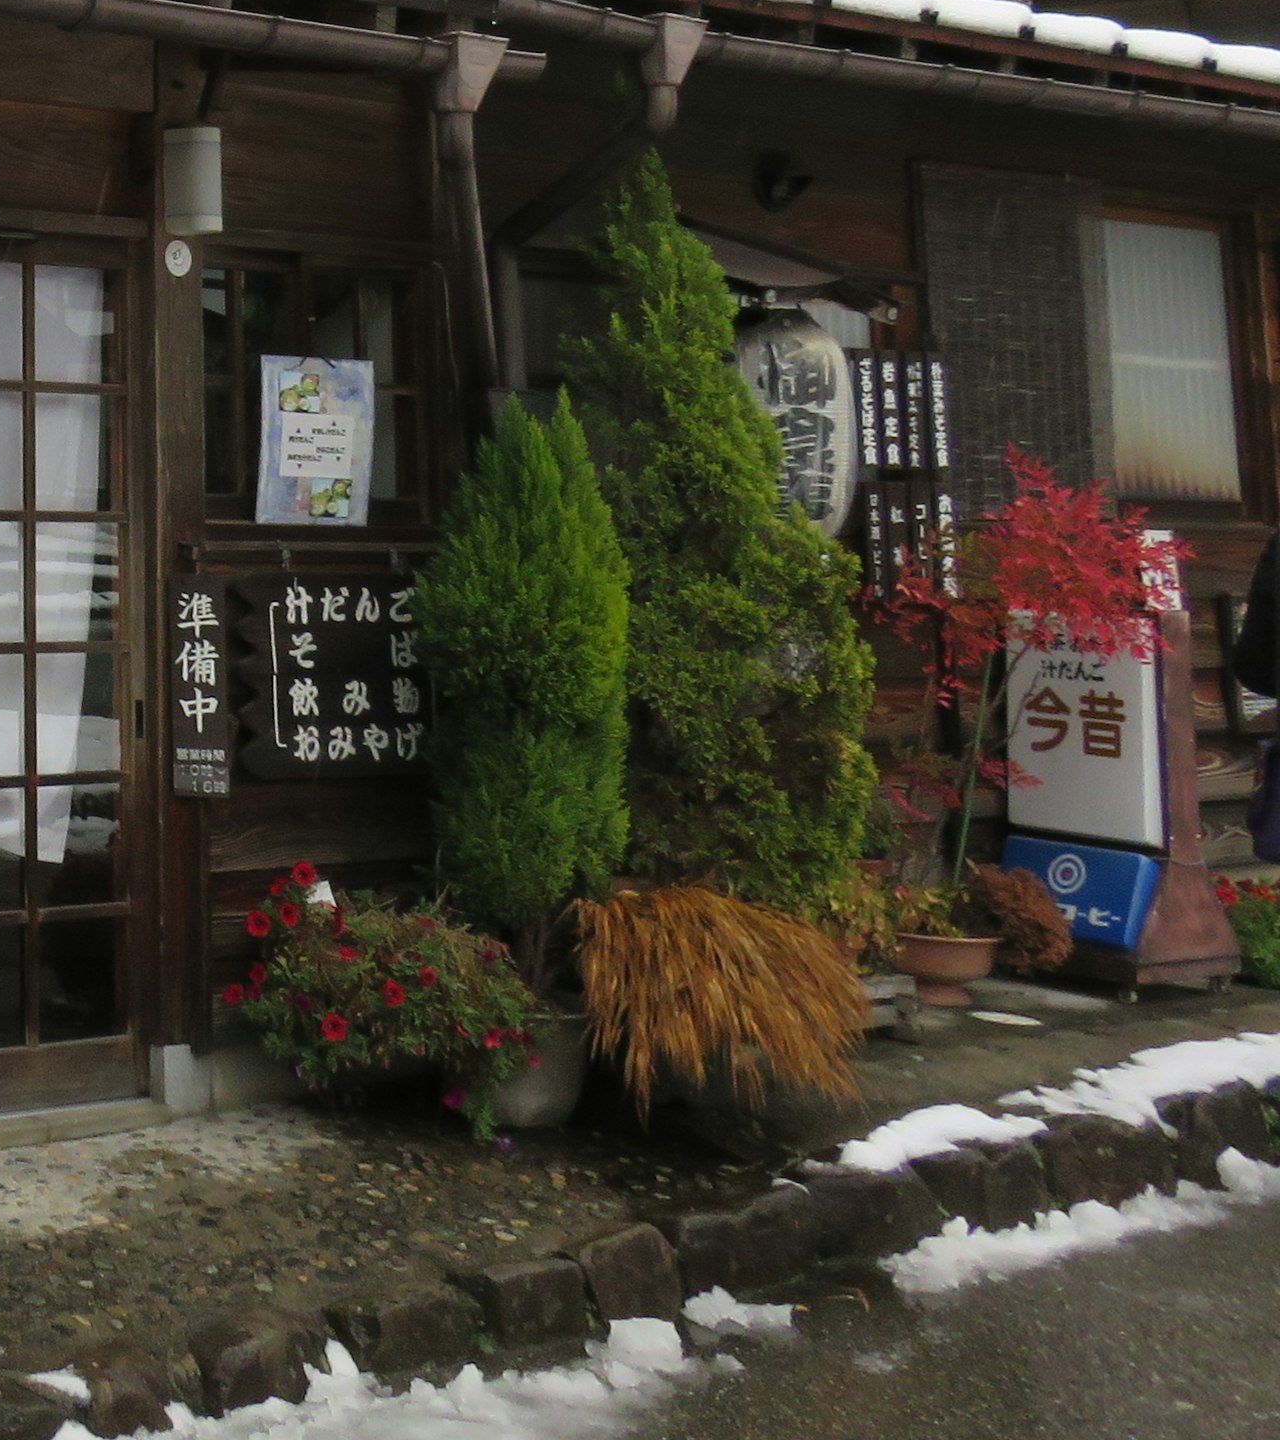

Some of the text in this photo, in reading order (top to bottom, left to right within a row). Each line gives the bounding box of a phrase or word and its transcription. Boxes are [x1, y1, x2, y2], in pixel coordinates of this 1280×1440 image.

[881, 361, 901, 465] 岩魚定食
[285, 584, 416, 625] 汁だんご
[174, 591, 220, 734] 準備中
[289, 630, 419, 669] そば
[289, 677, 420, 717] 飲み物
[293, 723, 425, 762] おみやげ
[1024, 686, 1127, 758] 今昔
